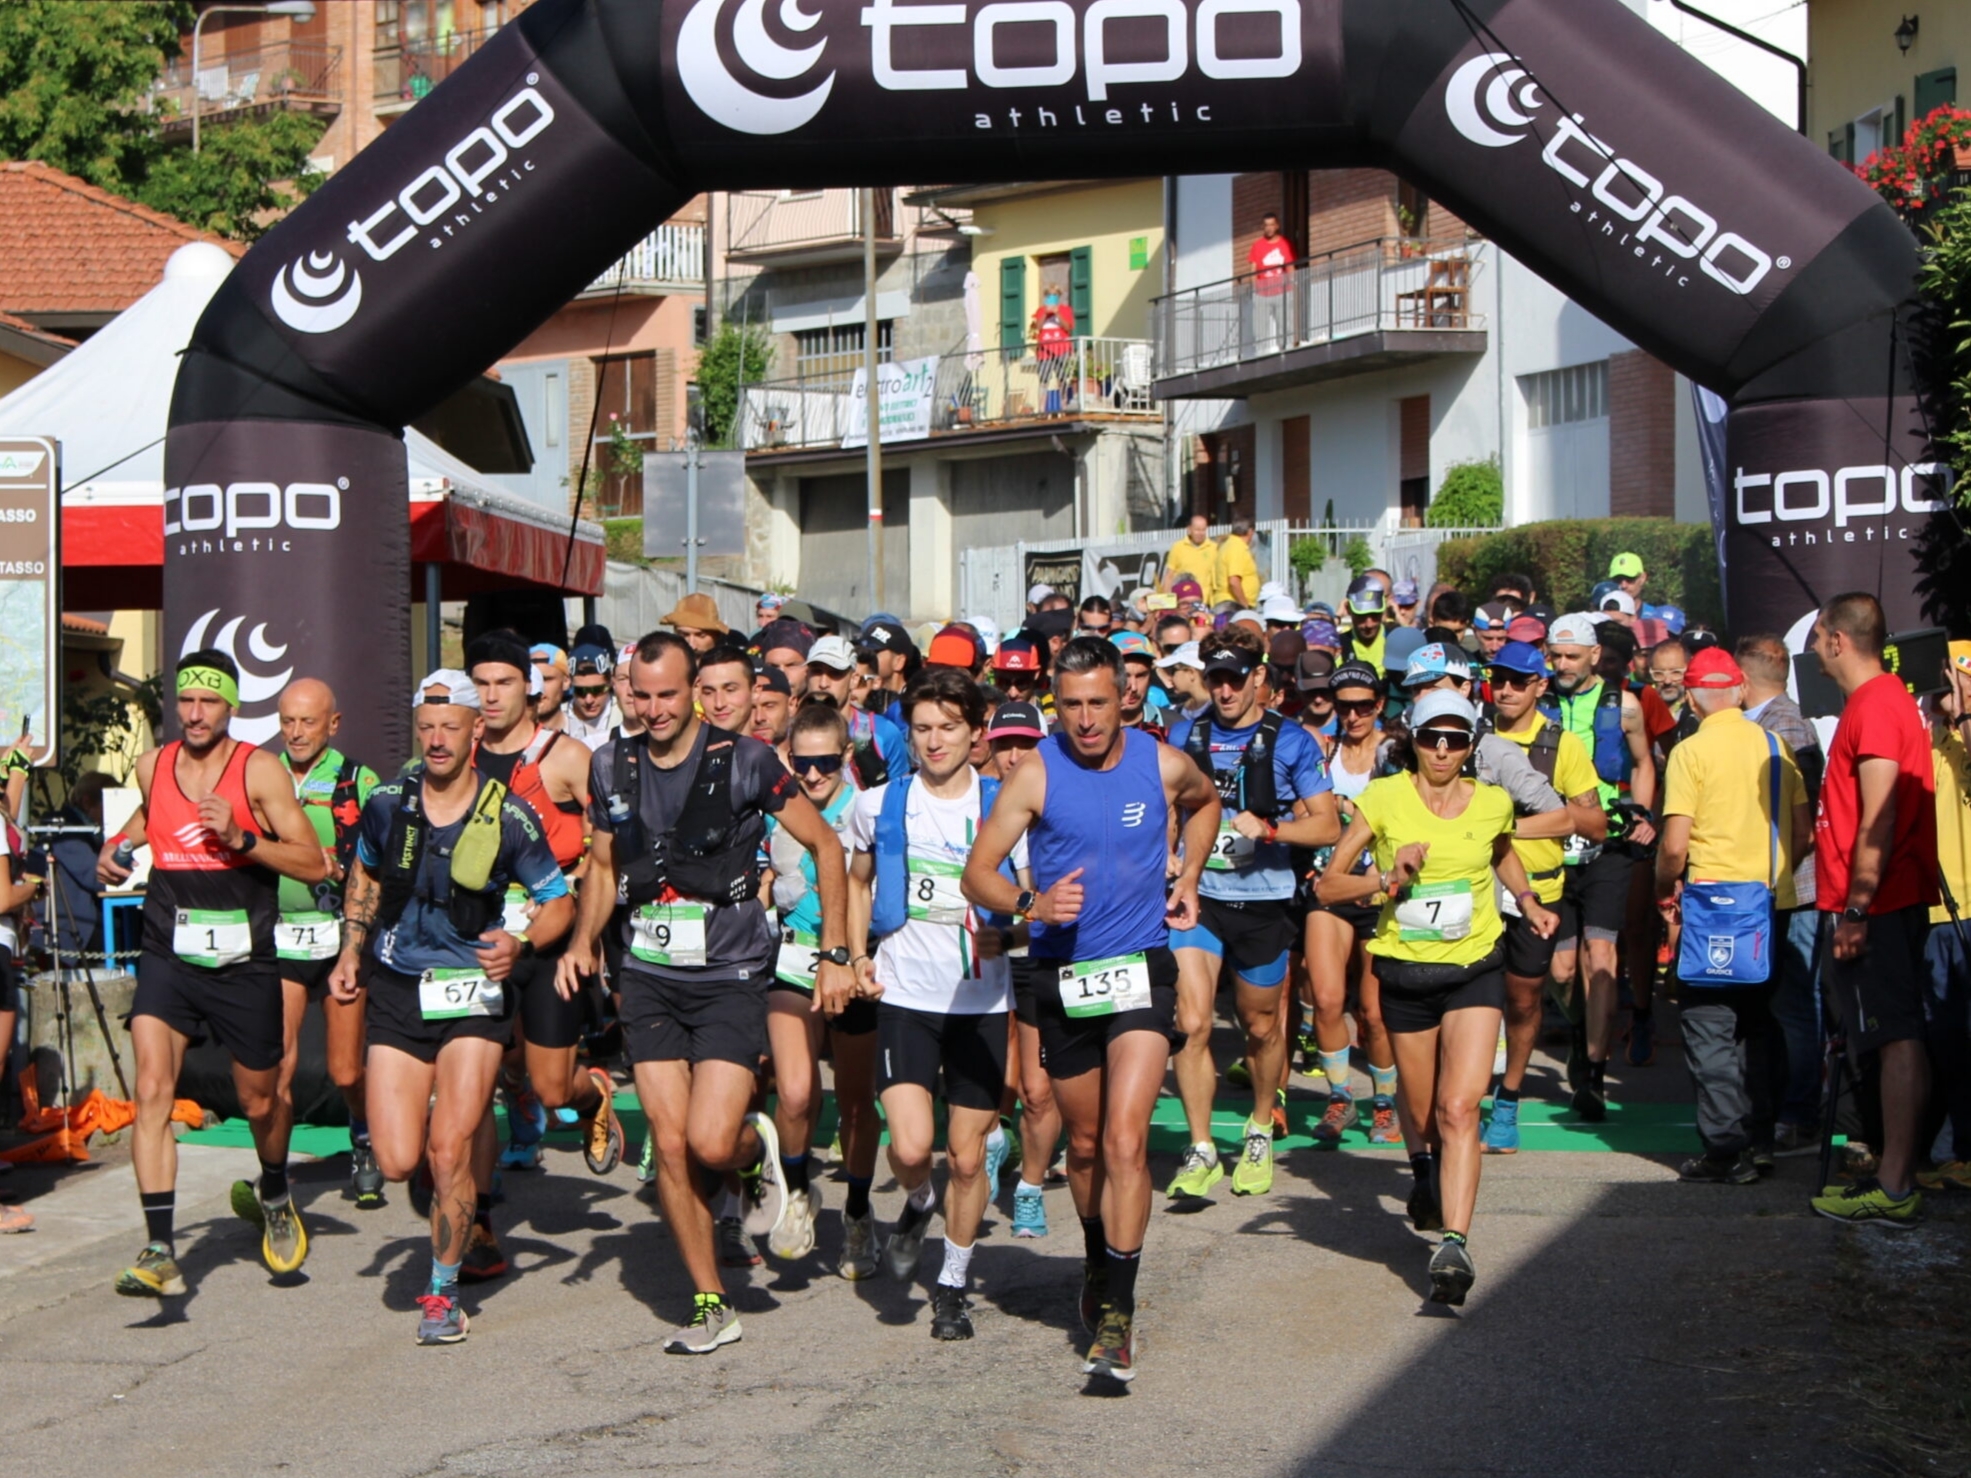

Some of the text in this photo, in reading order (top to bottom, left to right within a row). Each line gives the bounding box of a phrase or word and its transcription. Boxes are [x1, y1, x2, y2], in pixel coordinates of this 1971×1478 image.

[861, 0, 1302, 101] topo
[975, 102, 1211, 129] athletic
[347, 88, 554, 261] topo
[430, 159, 536, 249] athletic
[1542, 113, 1772, 295] topo
[1570, 201, 1690, 287] athletic
[1734, 462, 1955, 527] topo
[180, 538, 291, 555] athletic
[1772, 526, 1908, 548] athletic
[918, 878, 935, 902] 8
[1426, 900, 1441, 925] 7
[205, 929, 219, 951] 1
[292, 927, 319, 946] 71
[656, 924, 671, 948] 9
[445, 980, 479, 1004] 67
[1078, 967, 1132, 999] 135
